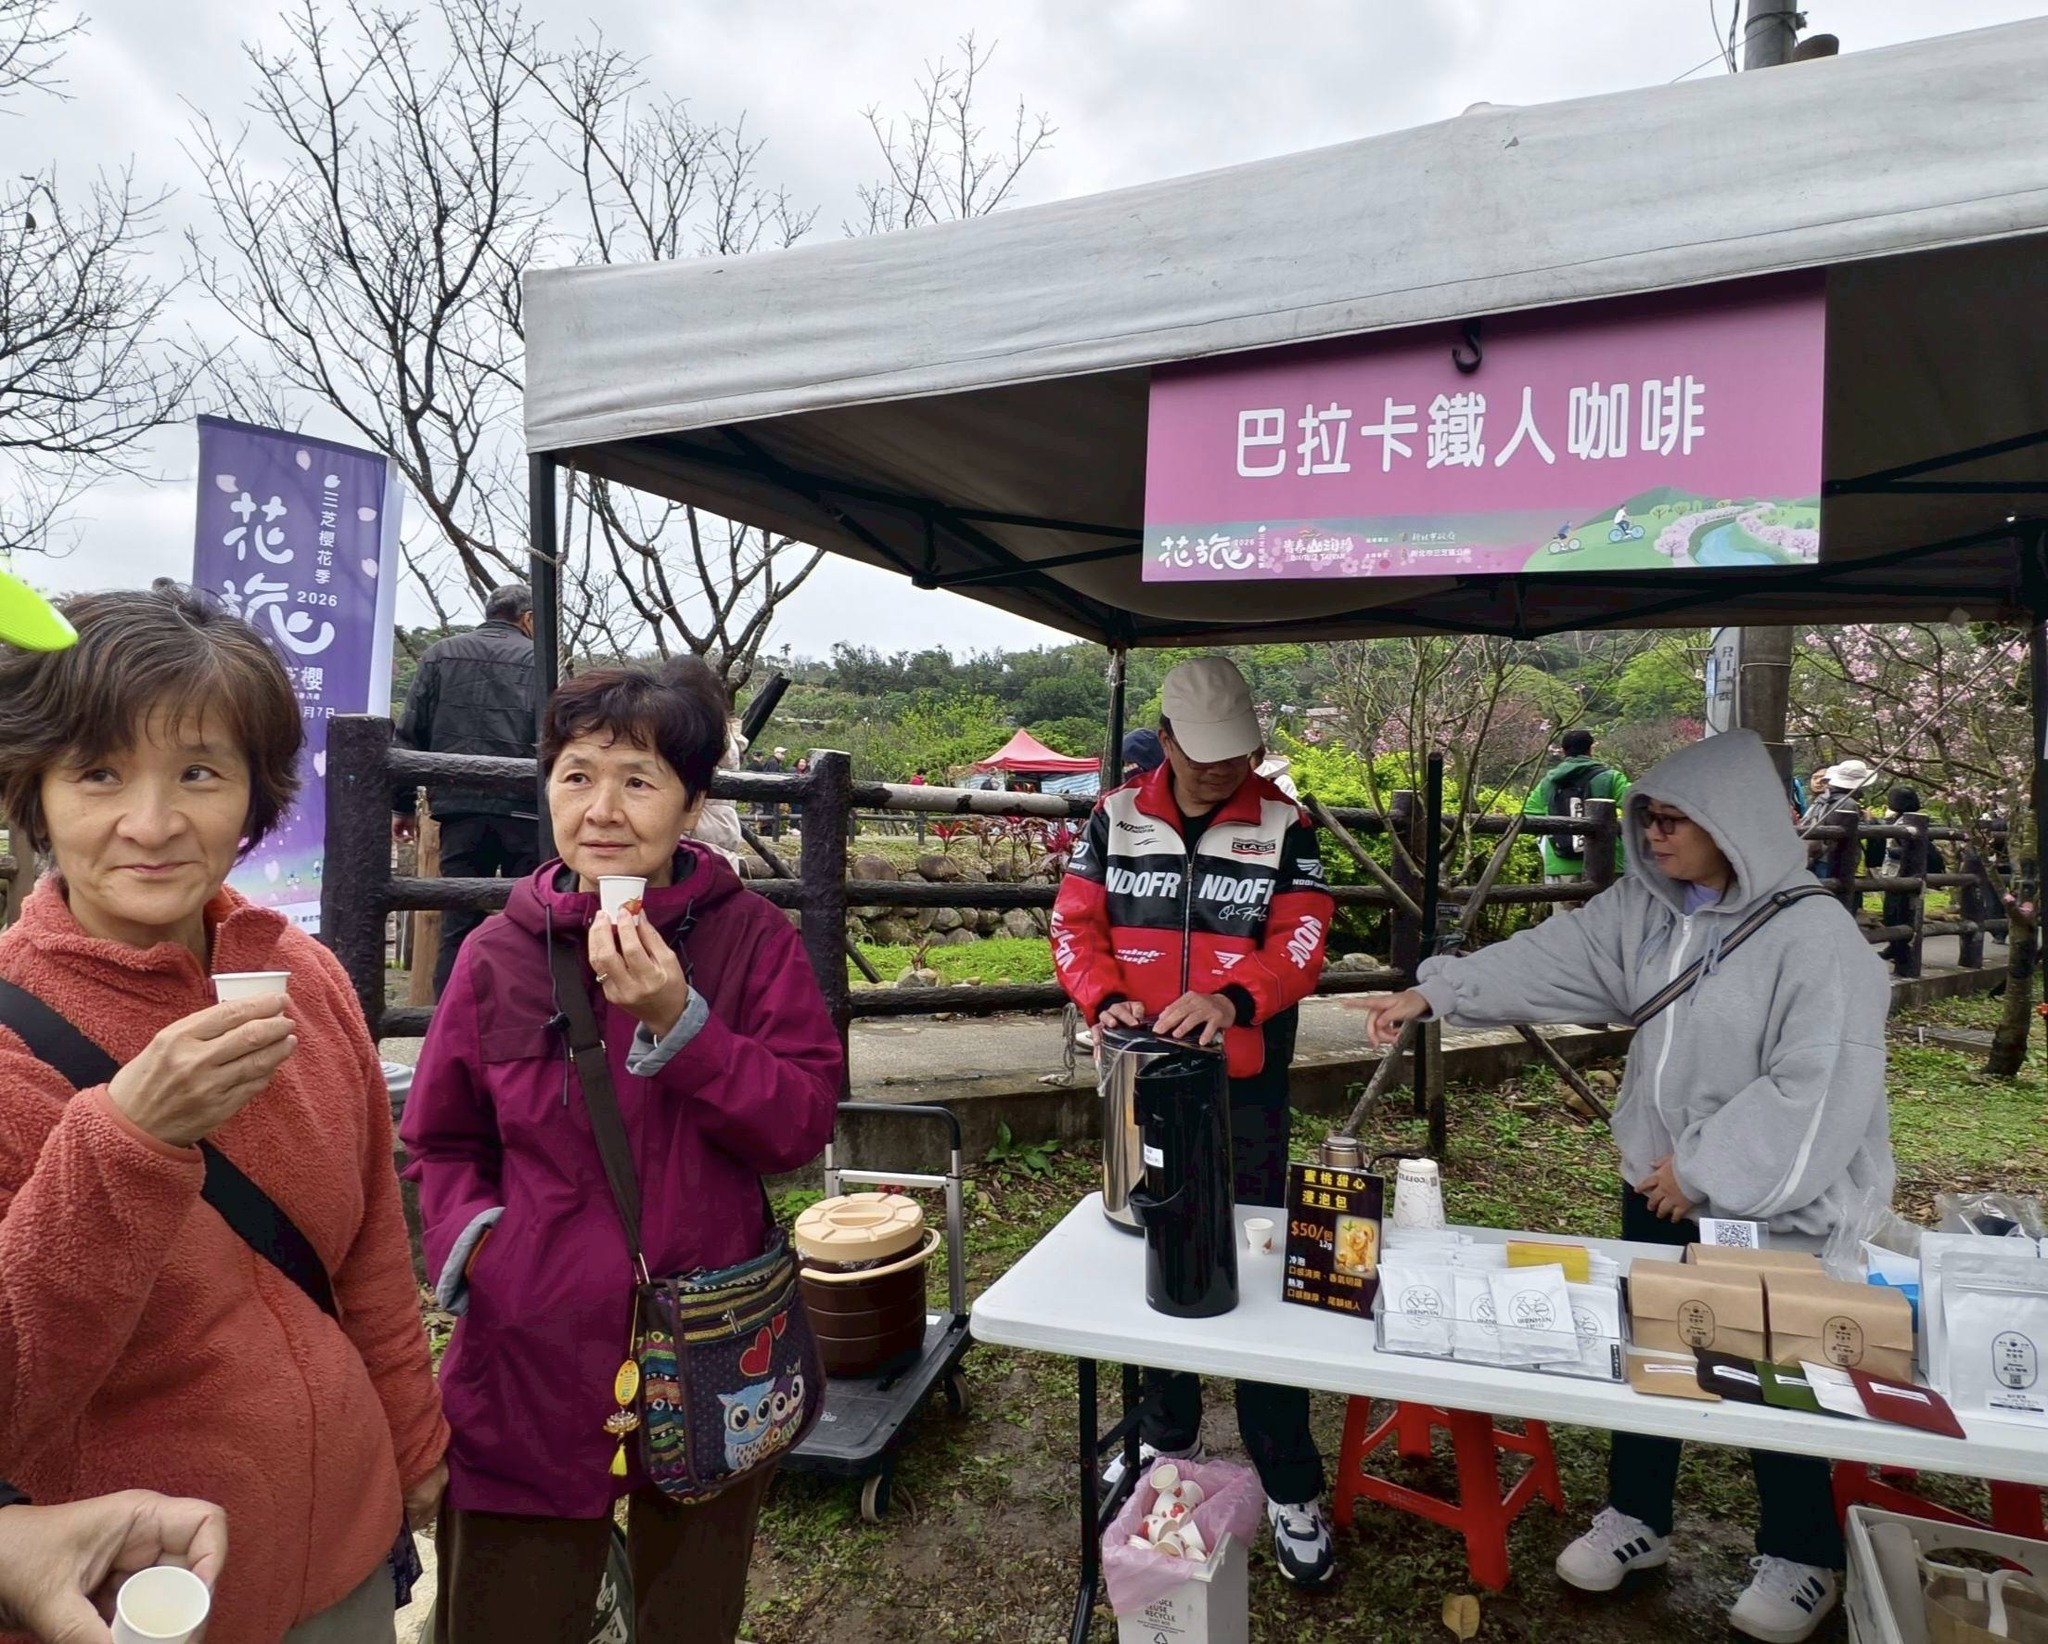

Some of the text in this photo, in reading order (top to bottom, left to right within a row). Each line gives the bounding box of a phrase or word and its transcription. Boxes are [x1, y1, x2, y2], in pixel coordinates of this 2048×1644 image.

[1236, 375, 1705, 477] 巴拉卡鐵人咖啡
[314, 491, 340, 584] 三芝櫻花季
[296, 591, 338, 607] 2026
[1105, 866, 1182, 899] NDOFR
[1303, 1169, 1366, 1191] 蜜桃甜心
[1302, 1189, 1348, 1209] 浸泡包
[1291, 1220, 1334, 1242] $50/包
[1319, 1239, 1333, 1251] 12g
[1144, 1609, 1176, 1622] RECYCLE
